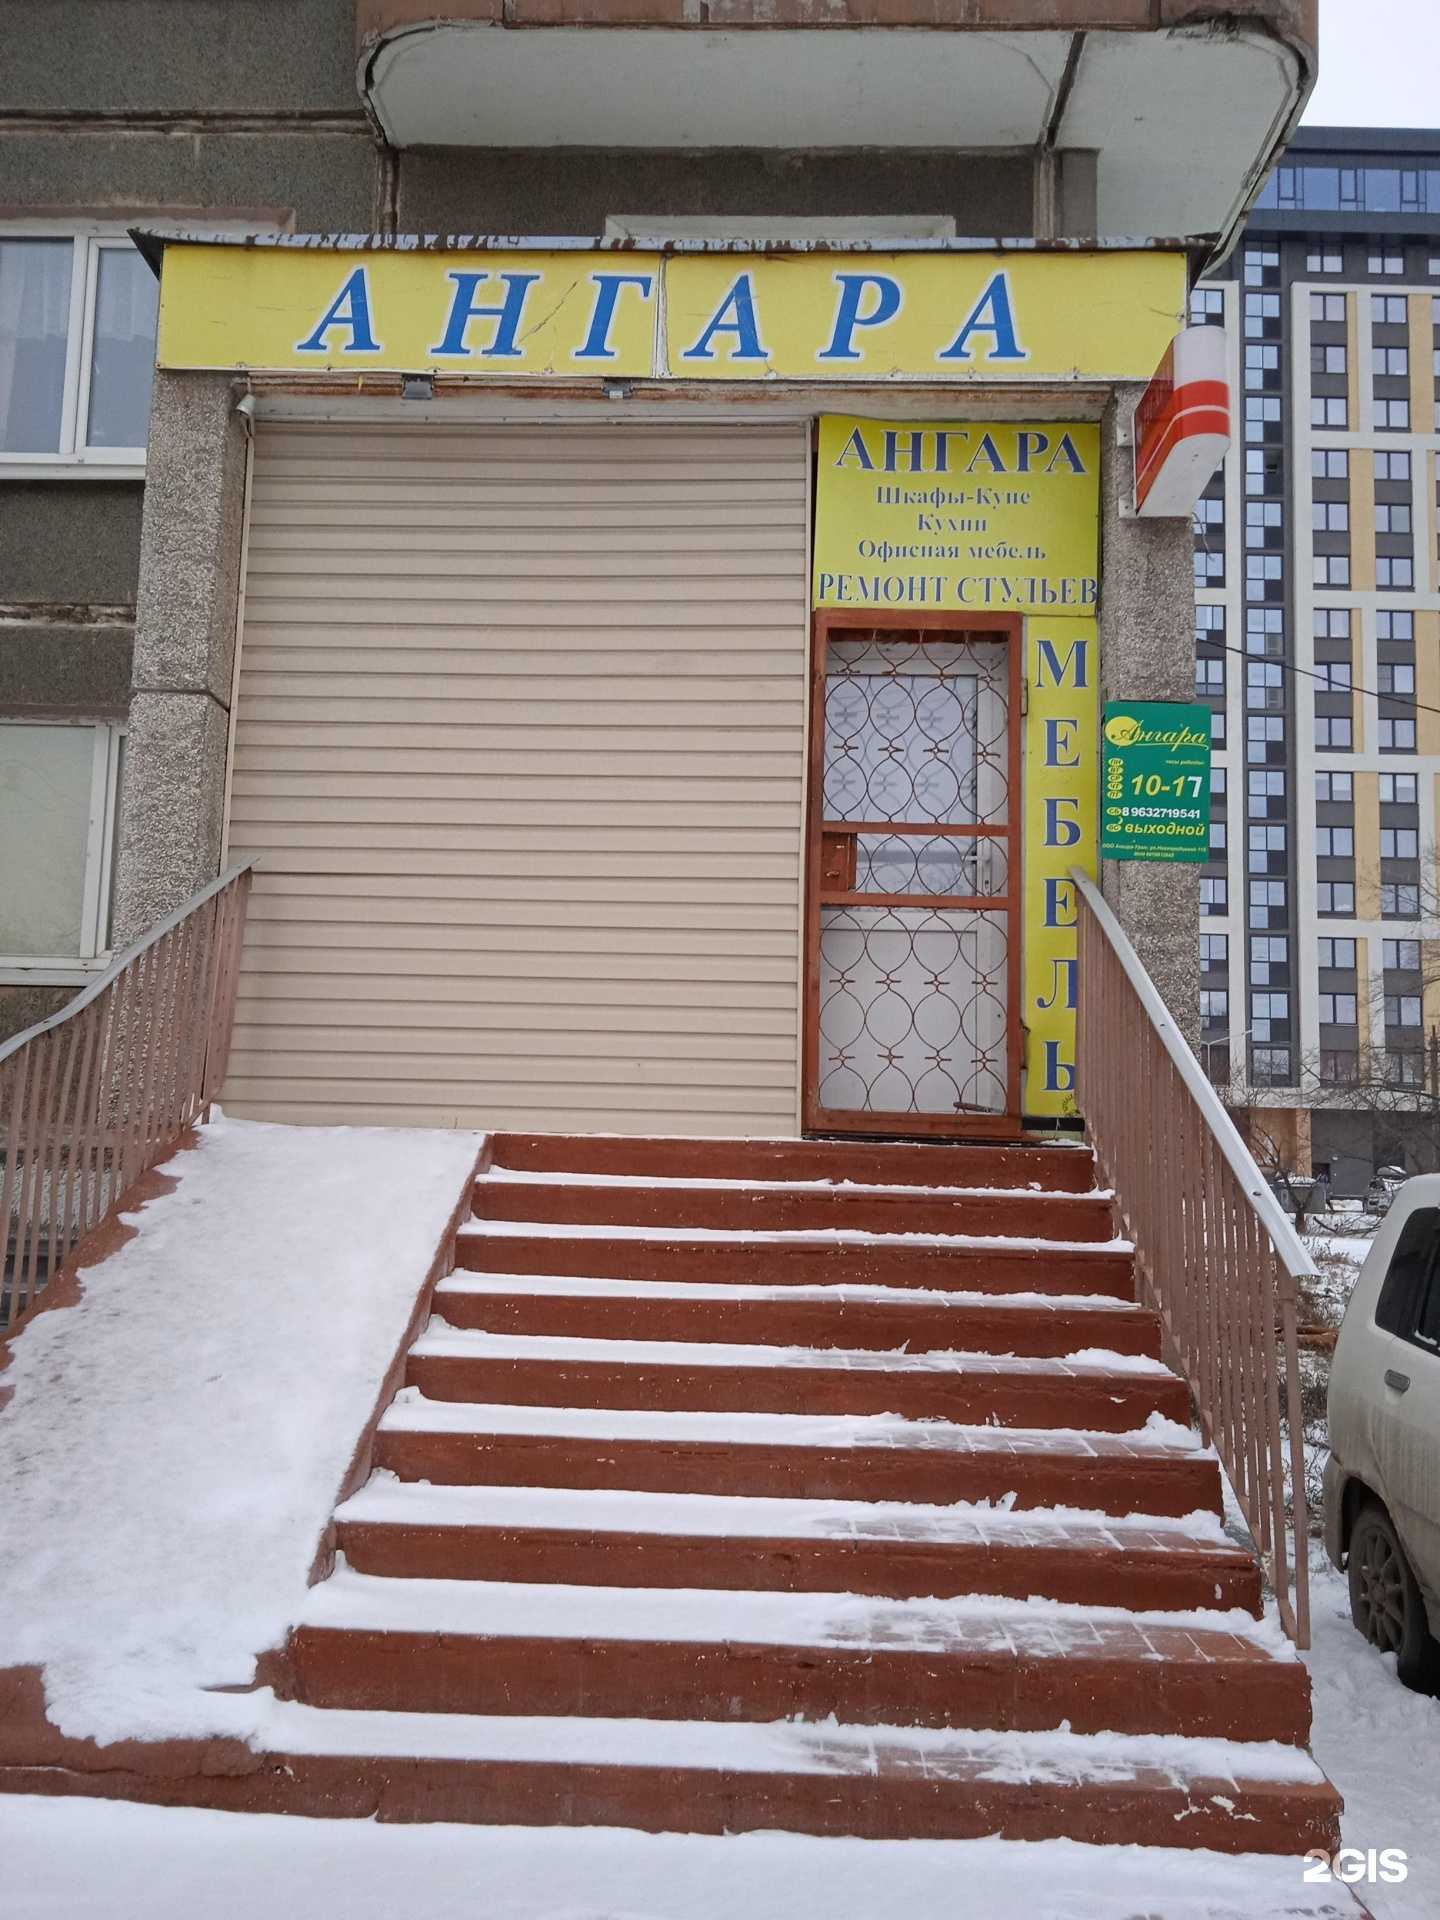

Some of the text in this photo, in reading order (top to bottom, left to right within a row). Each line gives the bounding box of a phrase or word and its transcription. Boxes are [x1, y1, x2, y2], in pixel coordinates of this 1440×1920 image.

[297, 267, 1028, 358] АНГАРА
[834, 425, 1088, 474] АНГАРА
[876, 486, 1031, 509] Шкафы-Купе
[917, 513, 987, 535] Кухни
[858, 539, 1046, 562] Офисная мебель
[819, 573, 1098, 604] РЕМОНТ СТУЛЬЕВ
[1110, 719, 1207, 752] Ангара
[1131, 774, 1203, 798] 10-17
[1125, 821, 1205, 835] выходной
[1035, 639, 1089, 1092] МЕБЕЛЬ
